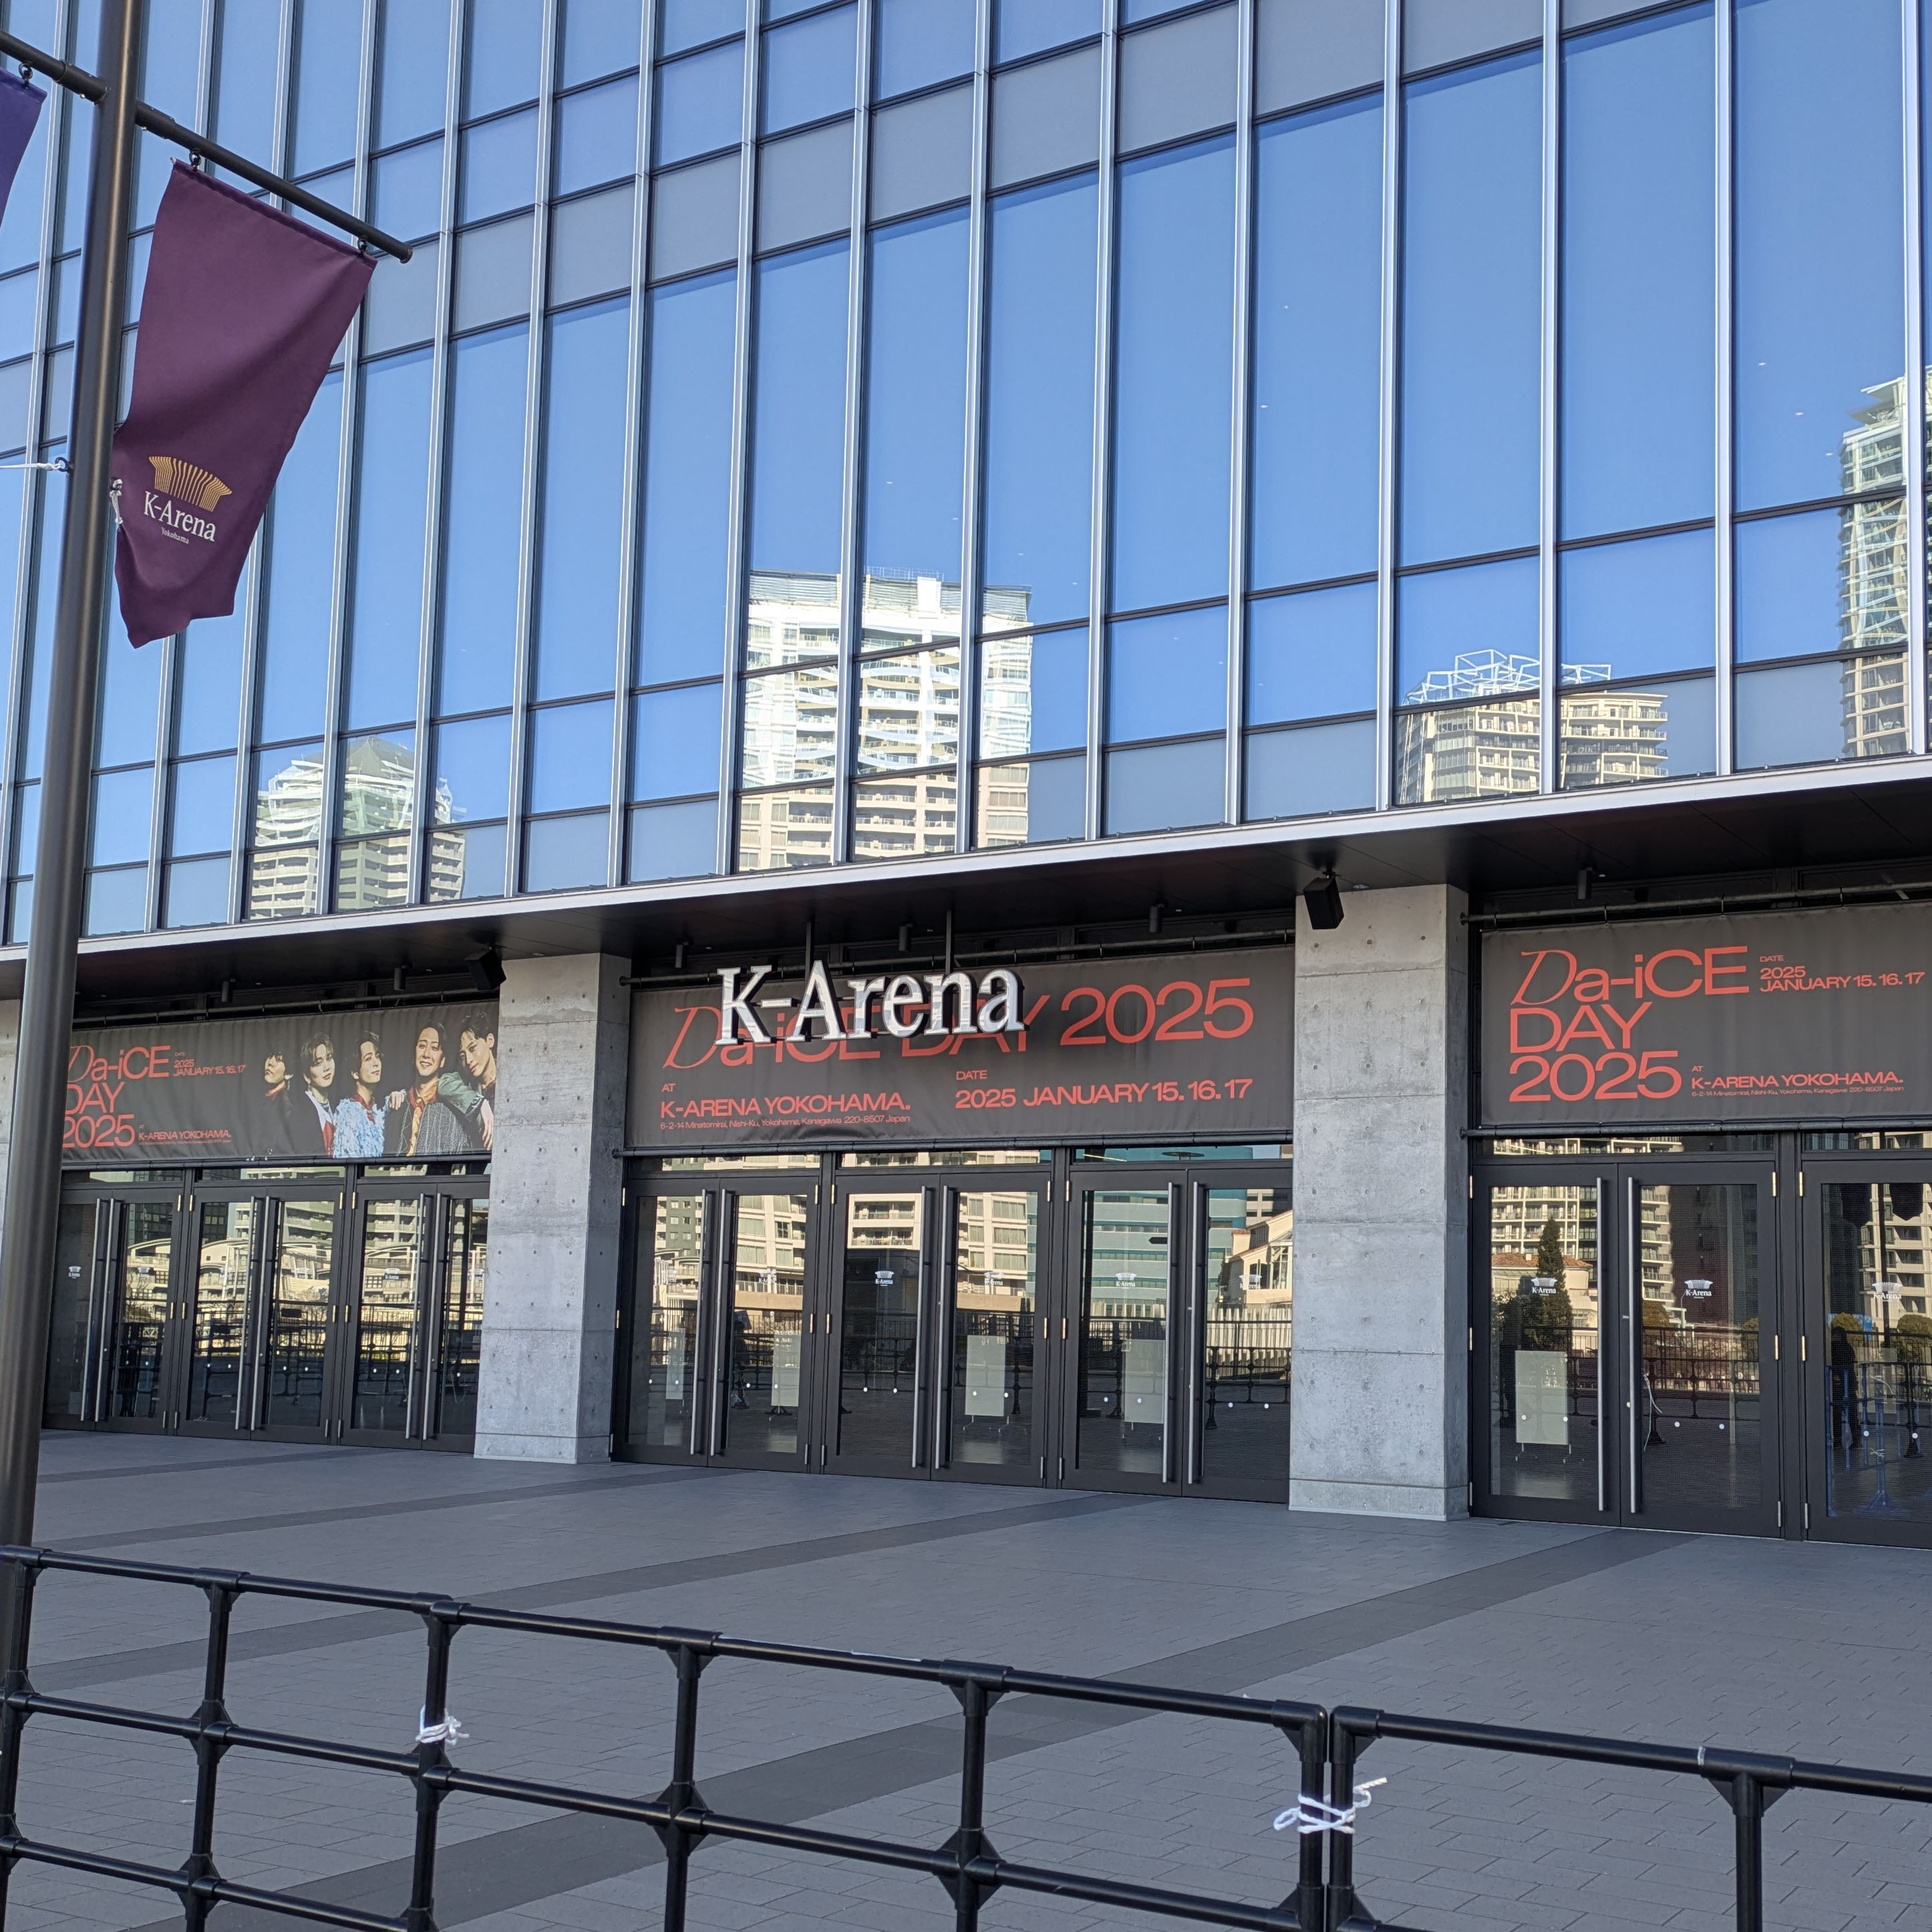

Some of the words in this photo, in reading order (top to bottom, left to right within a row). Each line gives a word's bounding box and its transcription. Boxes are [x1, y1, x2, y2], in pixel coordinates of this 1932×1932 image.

[144, 490, 216, 542] K-Arena
[162, 526, 189, 544] Yokohama
[1760, 955, 1784, 963] DATE
[1510, 945, 1750, 1007] Da-iCE
[1760, 966, 1806, 980] 2025
[1760, 975, 1852, 993] JANUARY
[1853, 975, 1877, 987] 15.
[1879, 973, 1903, 986] 16.
[1905, 971, 1925, 985] 17
[714, 960, 1025, 1046] K-Arena
[1060, 978, 1254, 1045] 2025
[1510, 1001, 1653, 1054] DAY
[67, 1045, 171, 1083] Da-iCE
[173, 1067, 214, 1077] JANUARY
[237, 1064, 246, 1074] 17
[174, 1059, 195, 1068] 2025
[956, 1070, 987, 1081] DATE
[1509, 1050, 1682, 1103] 2025
[1692, 1075, 1780, 1090] K-ARENA
[1781, 1071, 1904, 1087] YOKOHAMA.
[661, 1083, 676, 1092] AT
[955, 1088, 1016, 1109] 2025
[1023, 1082, 1149, 1107] JANUARY
[1152, 1082, 1184, 1102] 15.
[1188, 1080, 1221, 1100] 16.
[1225, 1078, 1253, 1099] 17
[65, 1081, 125, 1115] DAY
[660, 1098, 762, 1118] K-ARENA
[764, 1092, 911, 1115] YOKOHAMA.
[62, 1114, 136, 1148] 2025
[660, 1122, 685, 1130] 6-2-14
[802, 1117, 842, 1126] Kanagawa
[844, 1115, 884, 1124] 220-8507
[886, 1115, 910, 1124] Japan
[138, 1131, 177, 1141] K-ARENA
[1685, 1289, 1712, 1297] K-Arena
[1873, 1291, 1902, 1299] K-Arena
